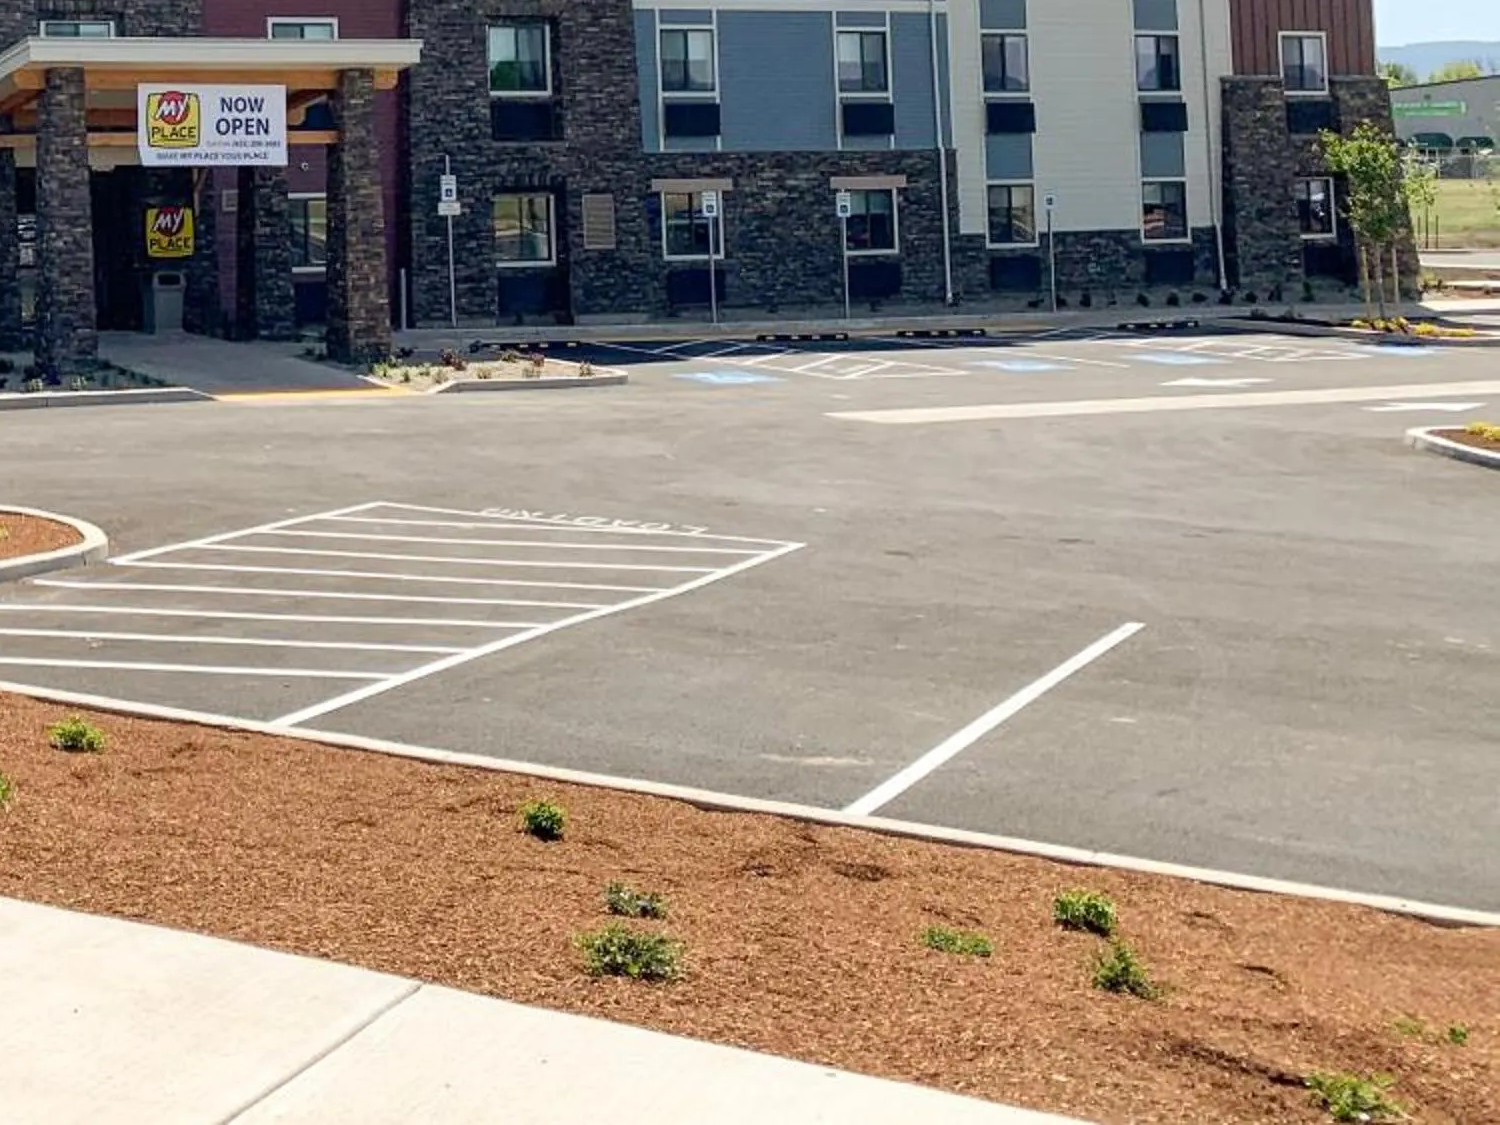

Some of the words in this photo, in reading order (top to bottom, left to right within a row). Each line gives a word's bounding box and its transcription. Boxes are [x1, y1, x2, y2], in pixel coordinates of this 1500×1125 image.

[220, 96, 266, 114] NOW
[151, 126, 197, 139] PLACE
[215, 117, 270, 136] OPEN
